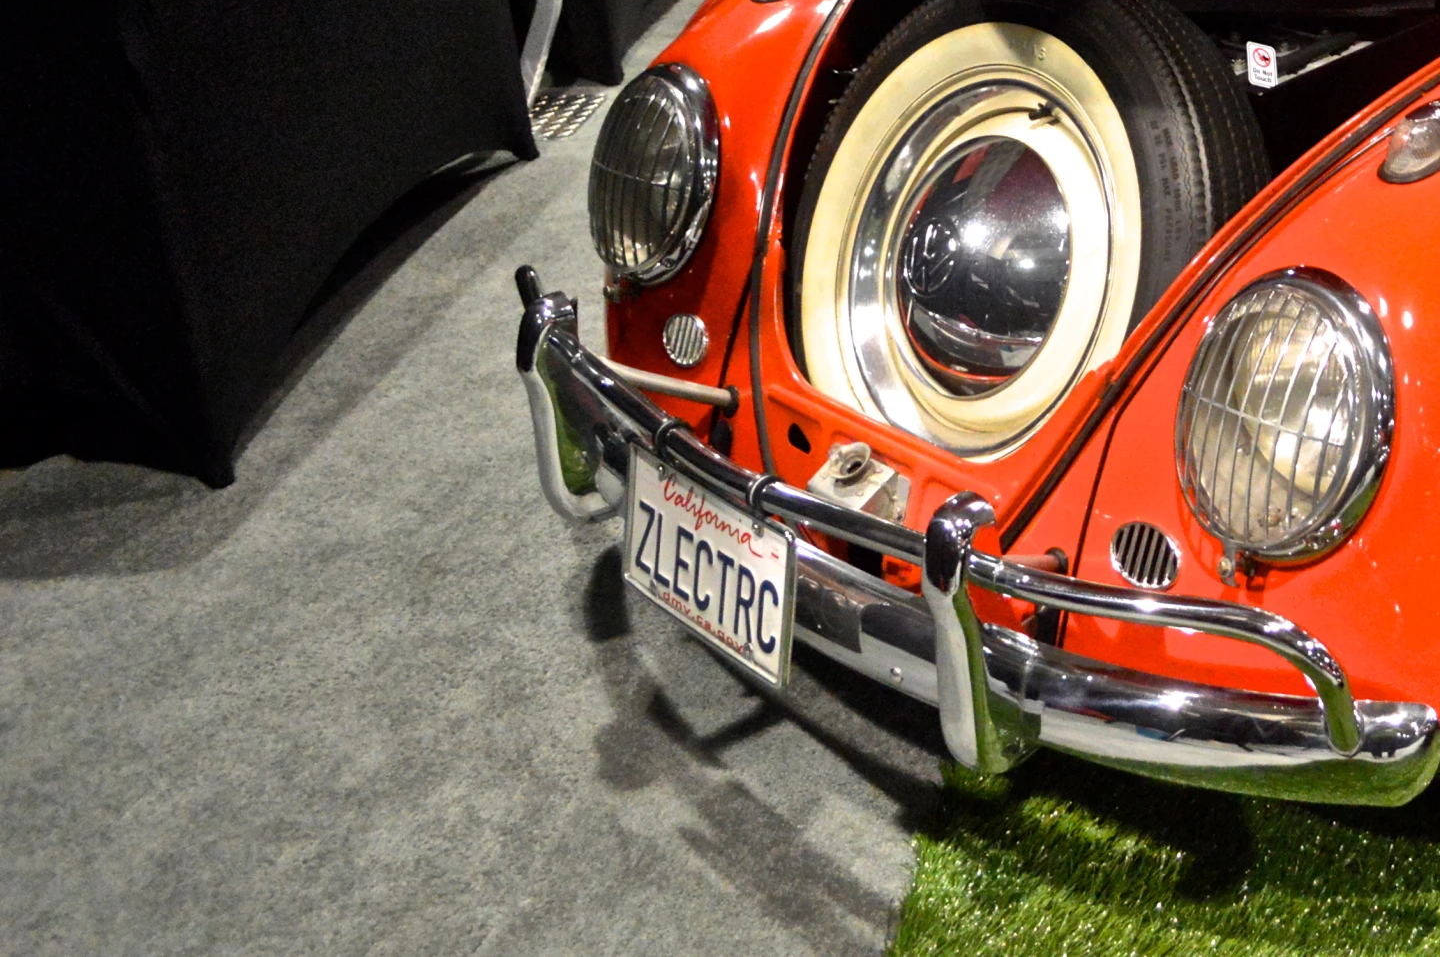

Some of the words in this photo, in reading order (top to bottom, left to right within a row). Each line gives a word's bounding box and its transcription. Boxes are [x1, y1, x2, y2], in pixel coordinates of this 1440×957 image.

[1254, 73, 1272, 83] Touch
[1262, 69, 1273, 77] Not
[663, 474, 763, 559] California
[635, 499, 779, 654] ZLECTRC
